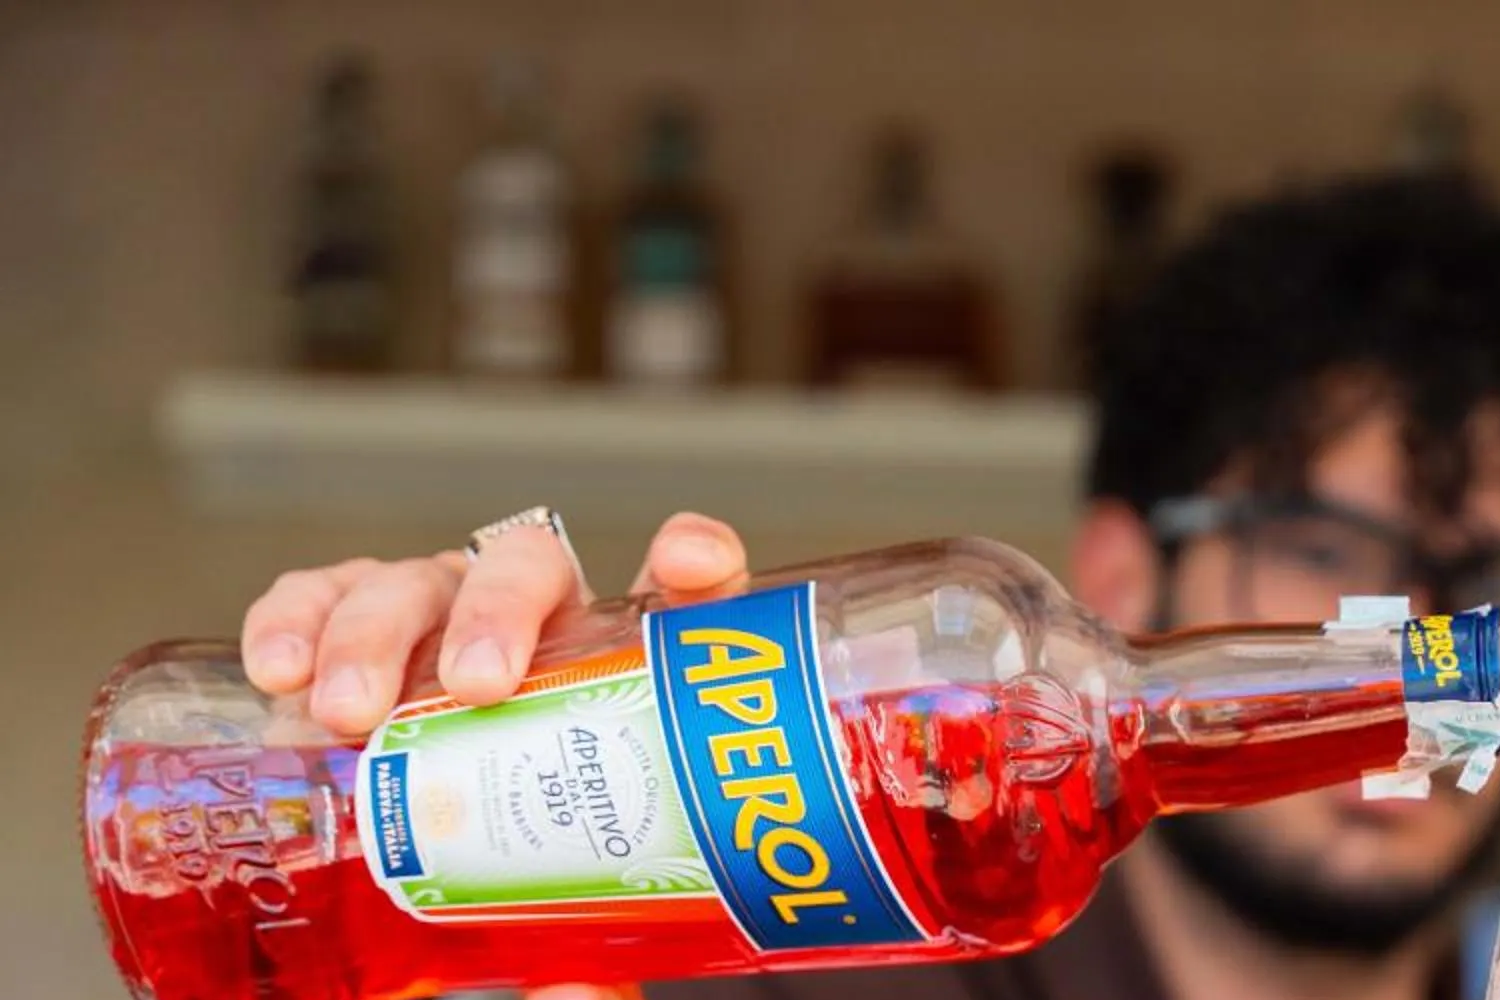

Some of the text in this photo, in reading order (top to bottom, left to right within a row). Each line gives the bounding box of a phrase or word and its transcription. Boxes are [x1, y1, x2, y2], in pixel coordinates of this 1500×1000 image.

[536, 769, 574, 828] 1919
[565, 778, 586, 815] DAL
[568, 725, 632, 858] APERITIVO
[678, 627, 850, 926] APEROL
